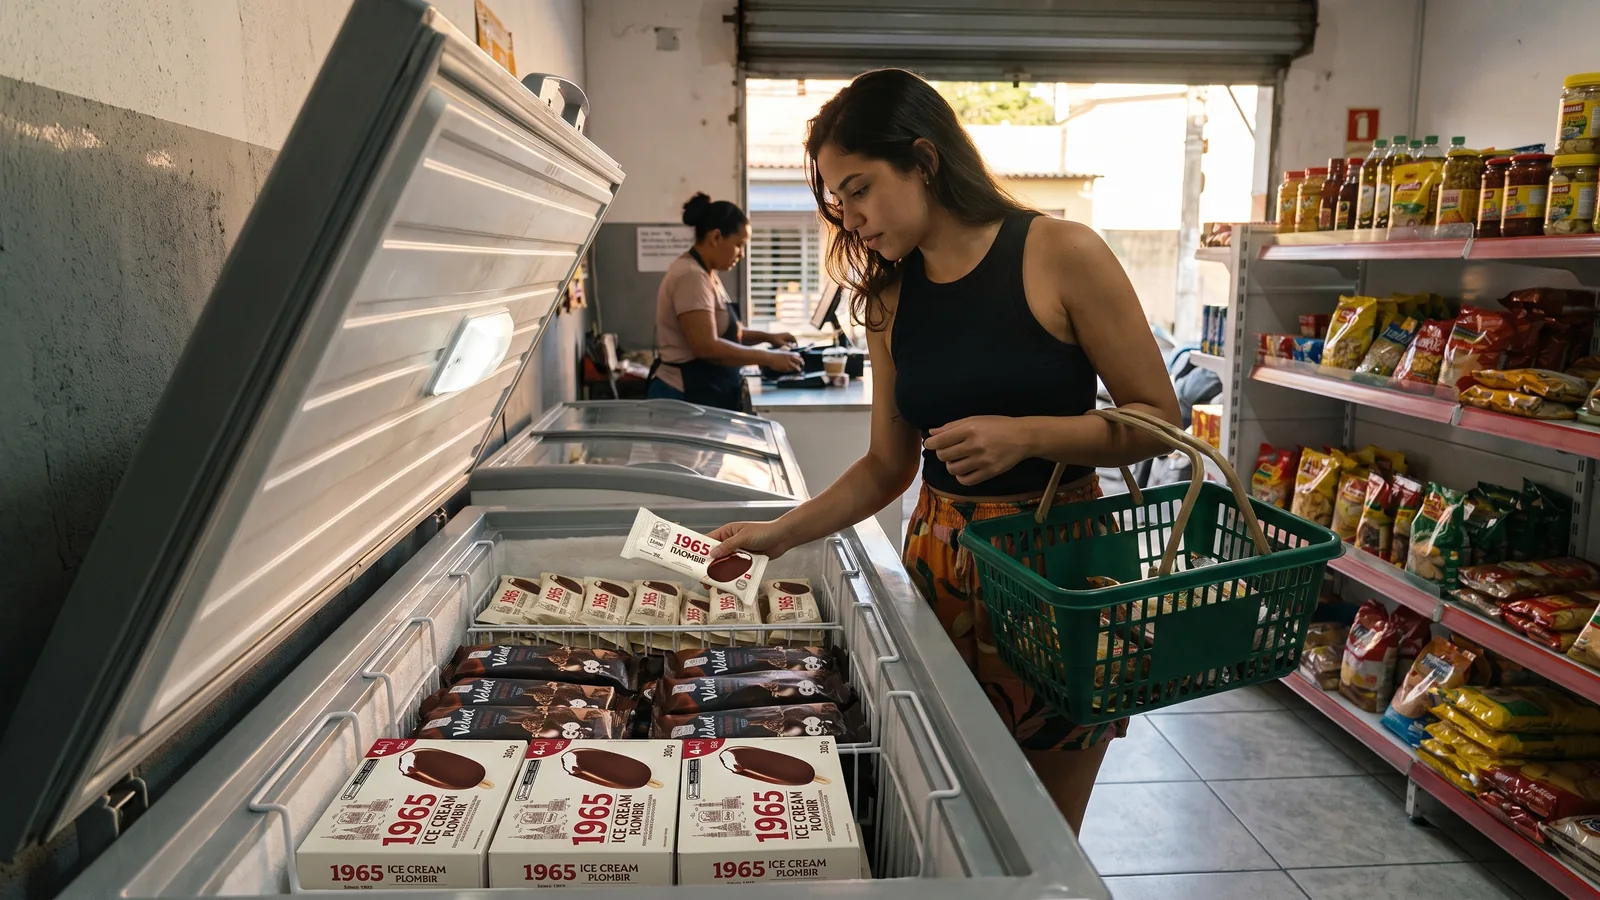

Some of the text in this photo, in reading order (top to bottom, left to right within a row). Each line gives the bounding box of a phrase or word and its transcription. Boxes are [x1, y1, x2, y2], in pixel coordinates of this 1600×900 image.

[674, 533, 711, 556] 1965
[453, 708, 475, 736] Velvet
[382, 793, 437, 846] 1965
[421, 795, 458, 845] ICE CREAM
[572, 793, 613, 845] 1965
[611, 794, 632, 843] ICE CREAM
[629, 802, 645, 835] PLOMBIR
[753, 790, 789, 843] 1965
[789, 791, 809, 839] ICE CREAM
[330, 864, 446, 881] 1965 ICE CREAM
[395, 874, 437, 883] PLOMBIR
[524, 864, 639, 881] 1965 ICE CREAM
[588, 873, 630, 882] PLOMBIR
[713, 859, 826, 878] 1965 ICE CREAM
[776, 868, 818, 877] PLOMBIR
